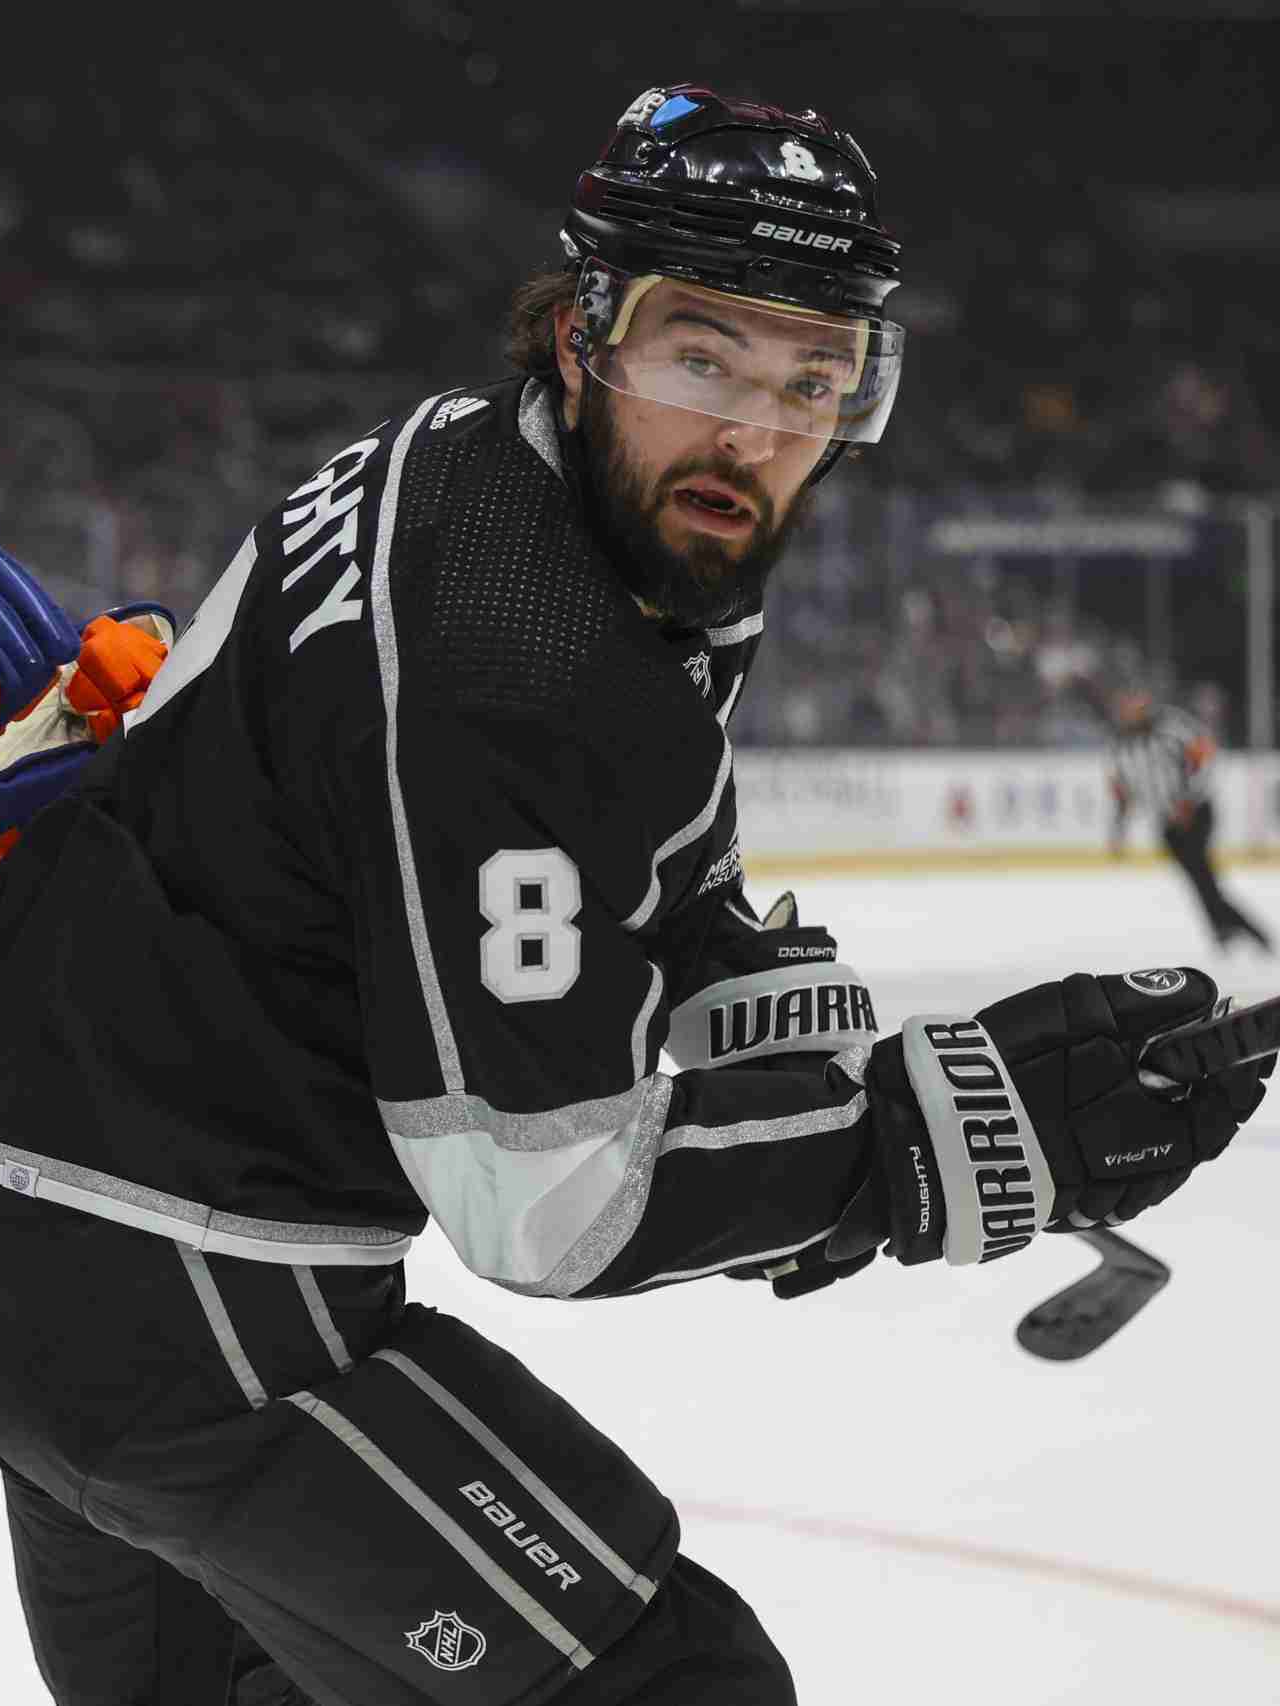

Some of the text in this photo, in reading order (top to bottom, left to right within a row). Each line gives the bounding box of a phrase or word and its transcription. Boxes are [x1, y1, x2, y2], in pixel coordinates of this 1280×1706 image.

[780, 141, 823, 182] 8
[751, 220, 853, 254] BAUER
[282, 437, 380, 655] GHTY
[478, 846, 583, 1004] 8
[709, 984, 879, 1060] WARR
[909, 1146, 930, 1234] DOUGHTY
[1104, 1143, 1173, 1167] ALPHA
[458, 1480, 582, 1592] BAUER
[439, 1626, 458, 1664] NHL
